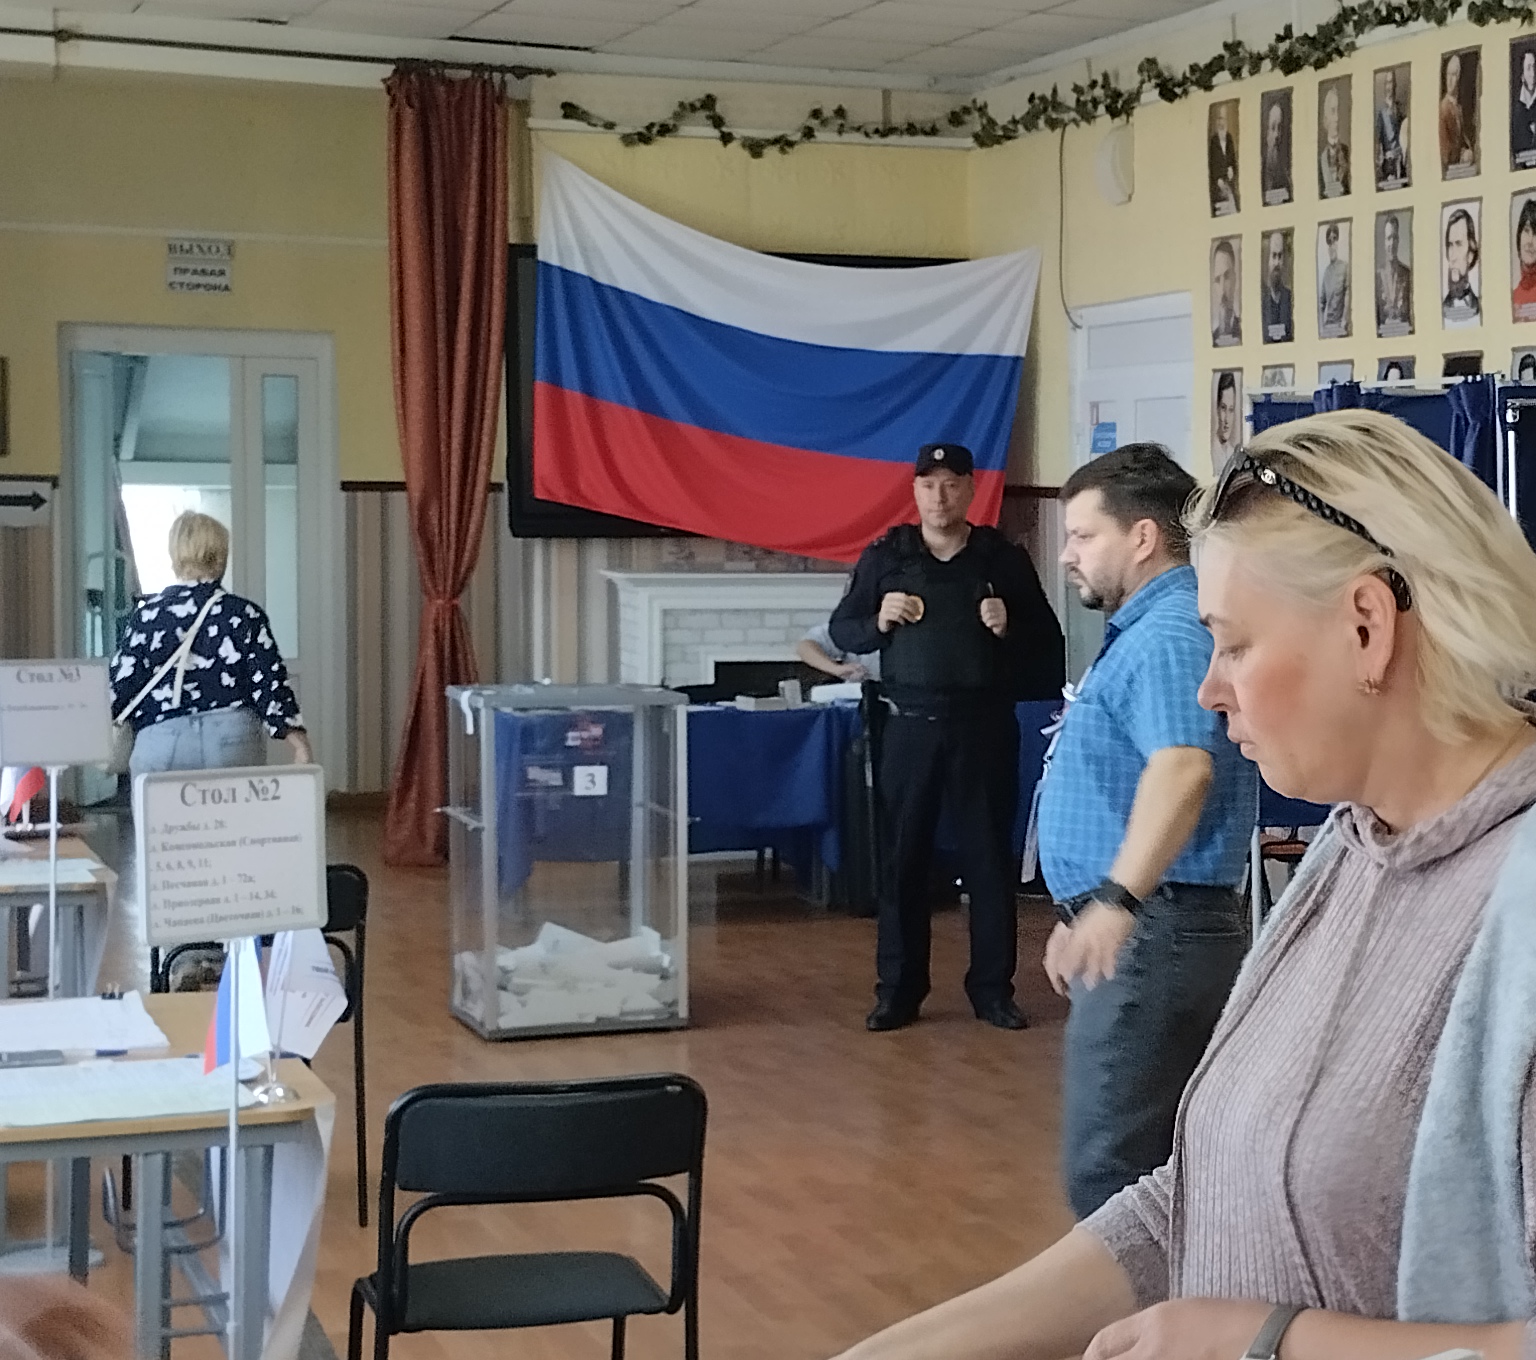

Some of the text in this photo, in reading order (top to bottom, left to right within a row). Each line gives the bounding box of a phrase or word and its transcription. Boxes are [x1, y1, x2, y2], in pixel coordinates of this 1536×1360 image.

[180, 778, 281, 807] Стол №2
[584, 772, 597, 791] 3
